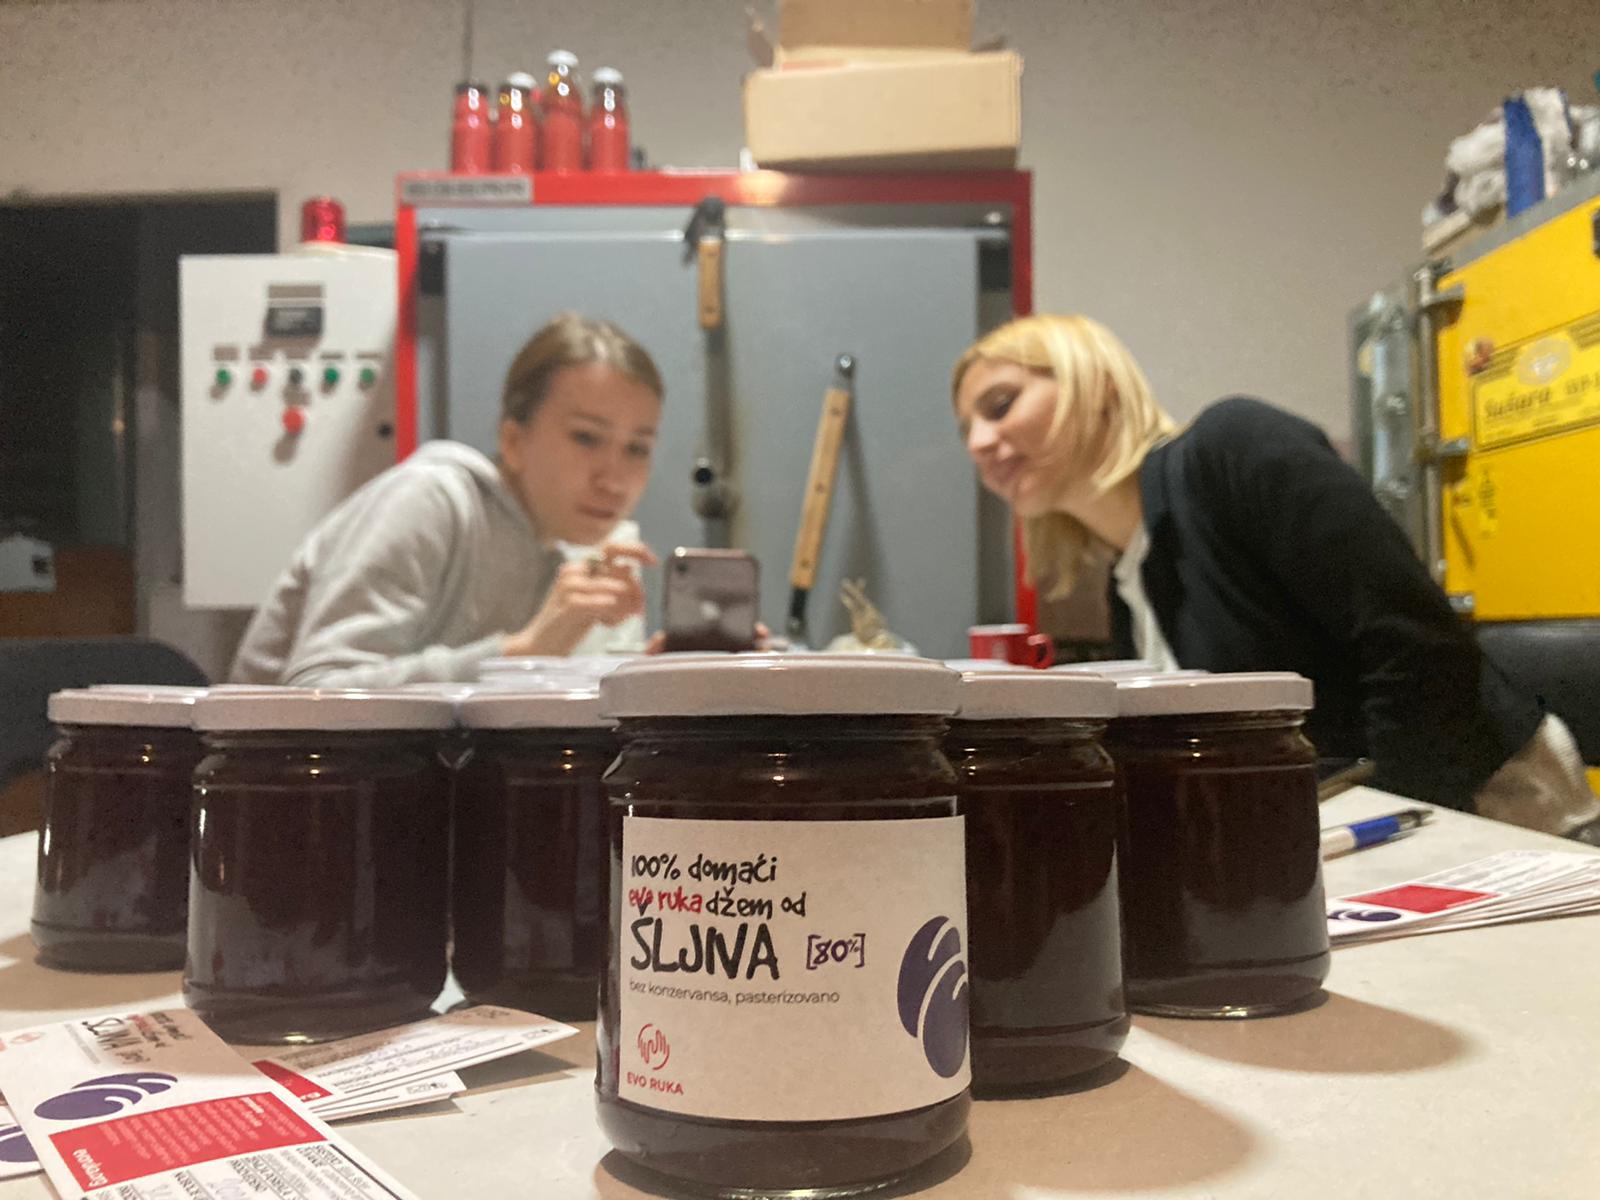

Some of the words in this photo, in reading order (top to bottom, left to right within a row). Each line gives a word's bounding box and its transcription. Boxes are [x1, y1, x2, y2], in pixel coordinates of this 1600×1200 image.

[631, 853, 681, 880] 100%
[688, 853, 778, 885] domaći
[657, 886, 703, 914] ruka
[705, 887, 773, 919] džem
[781, 891, 807, 917] od
[629, 977, 647, 993] bez
[648, 980, 733, 1004] konzervansa,
[735, 990, 840, 1006] pasterizovano
[627, 1071, 647, 1088] EVO
[650, 1078, 684, 1096] RUKA
